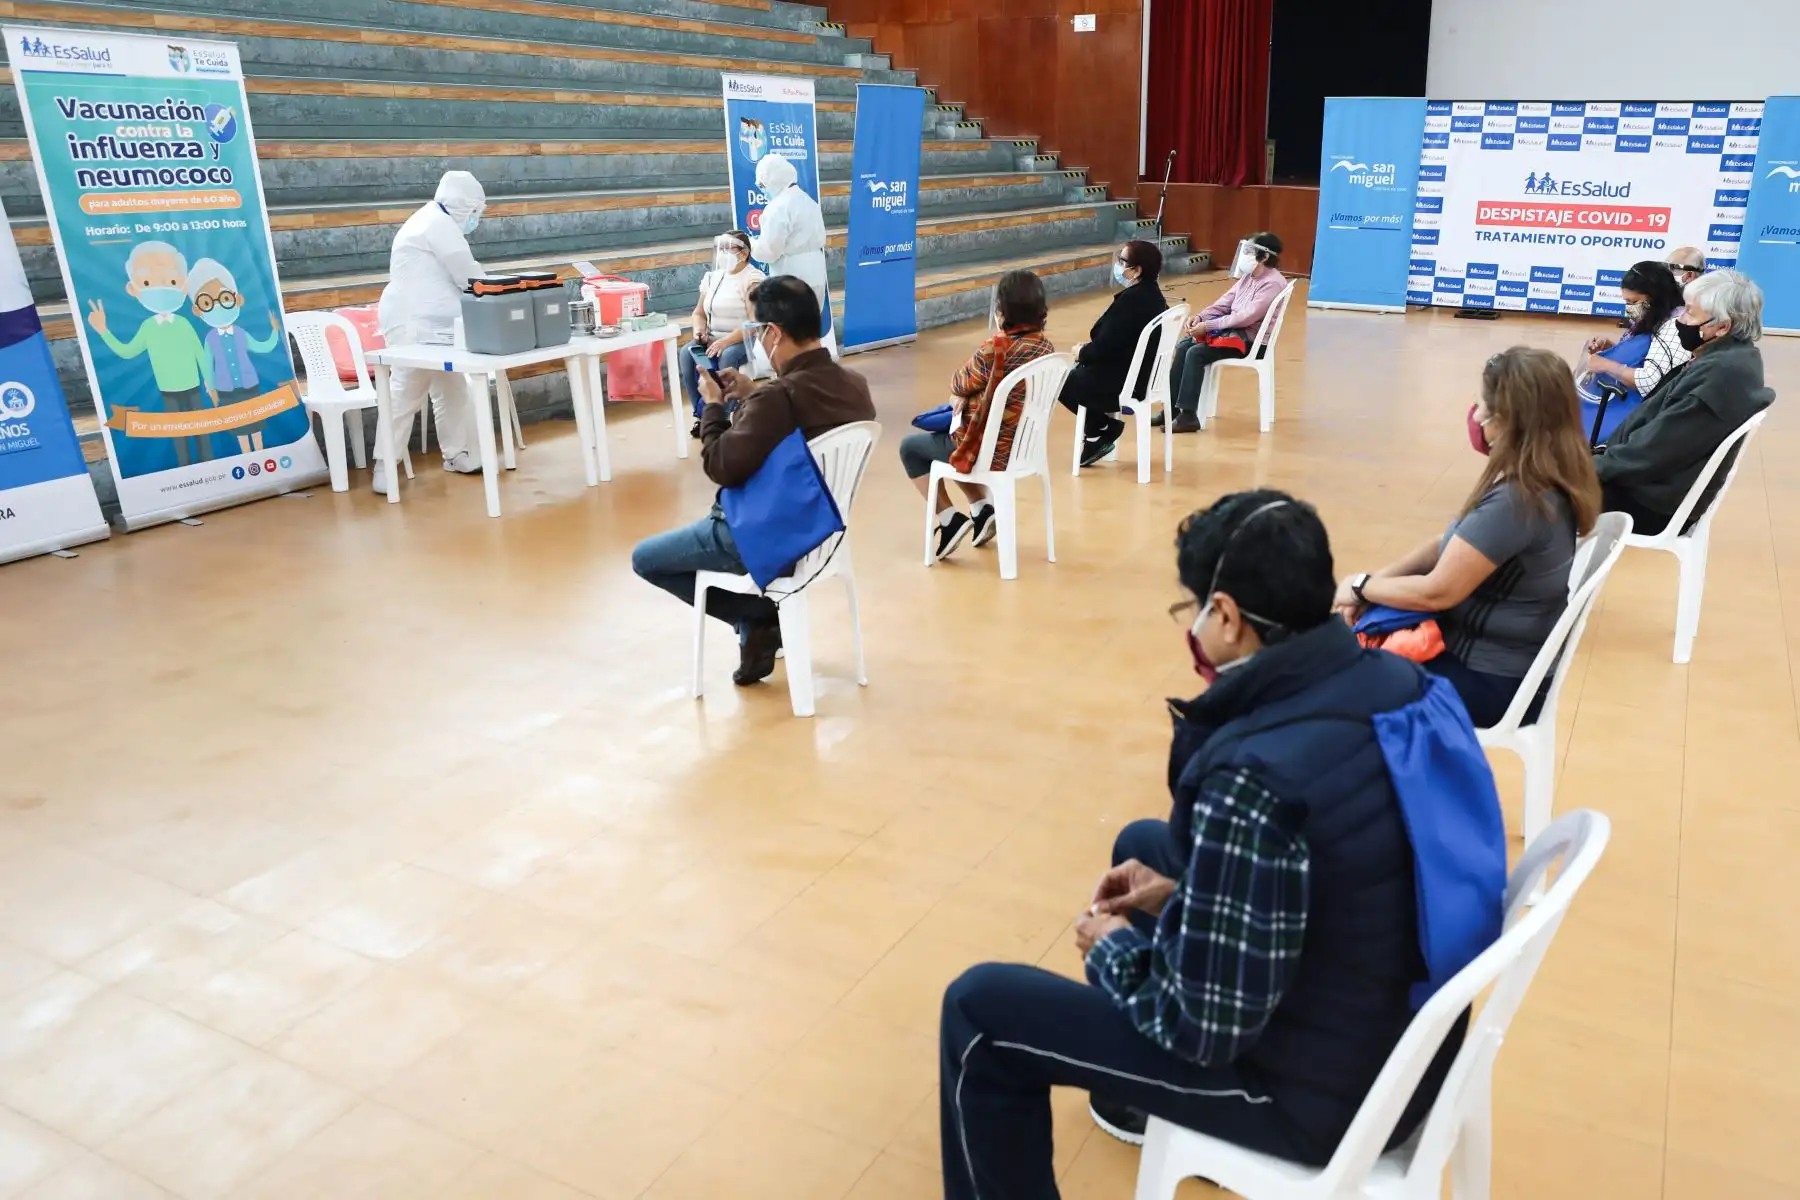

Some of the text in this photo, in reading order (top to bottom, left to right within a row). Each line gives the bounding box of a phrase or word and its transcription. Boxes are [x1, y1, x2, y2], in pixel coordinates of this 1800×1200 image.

[52, 45, 111, 61] EsSalud
[193, 50, 226, 59] EsSalud
[206, 58, 229, 67] Cuida
[740, 84, 762, 93] EsSalud
[57, 98, 205, 120] Vacunación
[116, 122, 193, 138] contra la
[769, 123, 803, 134] EsSalud
[68, 134, 219, 160] influenza y
[770, 135, 805, 147] Te Cuida
[1372, 163, 1395, 173] san
[78, 168, 232, 187] neumococo
[1349, 172, 1394, 188] miguel
[890, 181, 906, 192] san
[1561, 181, 1631, 198] EsSalud
[88, 199, 109, 210] para
[111, 197, 150, 208] adultos
[872, 192, 906, 211] miguel
[1330, 213, 1403, 224] ¡Vamos por más!
[1479, 207, 1573, 226] DESPISTAJE
[1578, 210, 1633, 225] COVID
[1648, 213, 1667, 226] 19
[85, 219, 247, 236] Horario: De 9:00 a 13:00 horas
[1475, 230, 1666, 249] TRATAMIENTO OPORTUNO
[885, 244, 896, 256] por
[897, 241, 913, 252] más!
[0, 423, 30, 440] ÑOS
[131, 421, 148, 431] Por
[8, 438, 40, 450] MIGUEL
[0, 507, 15, 520] RA
